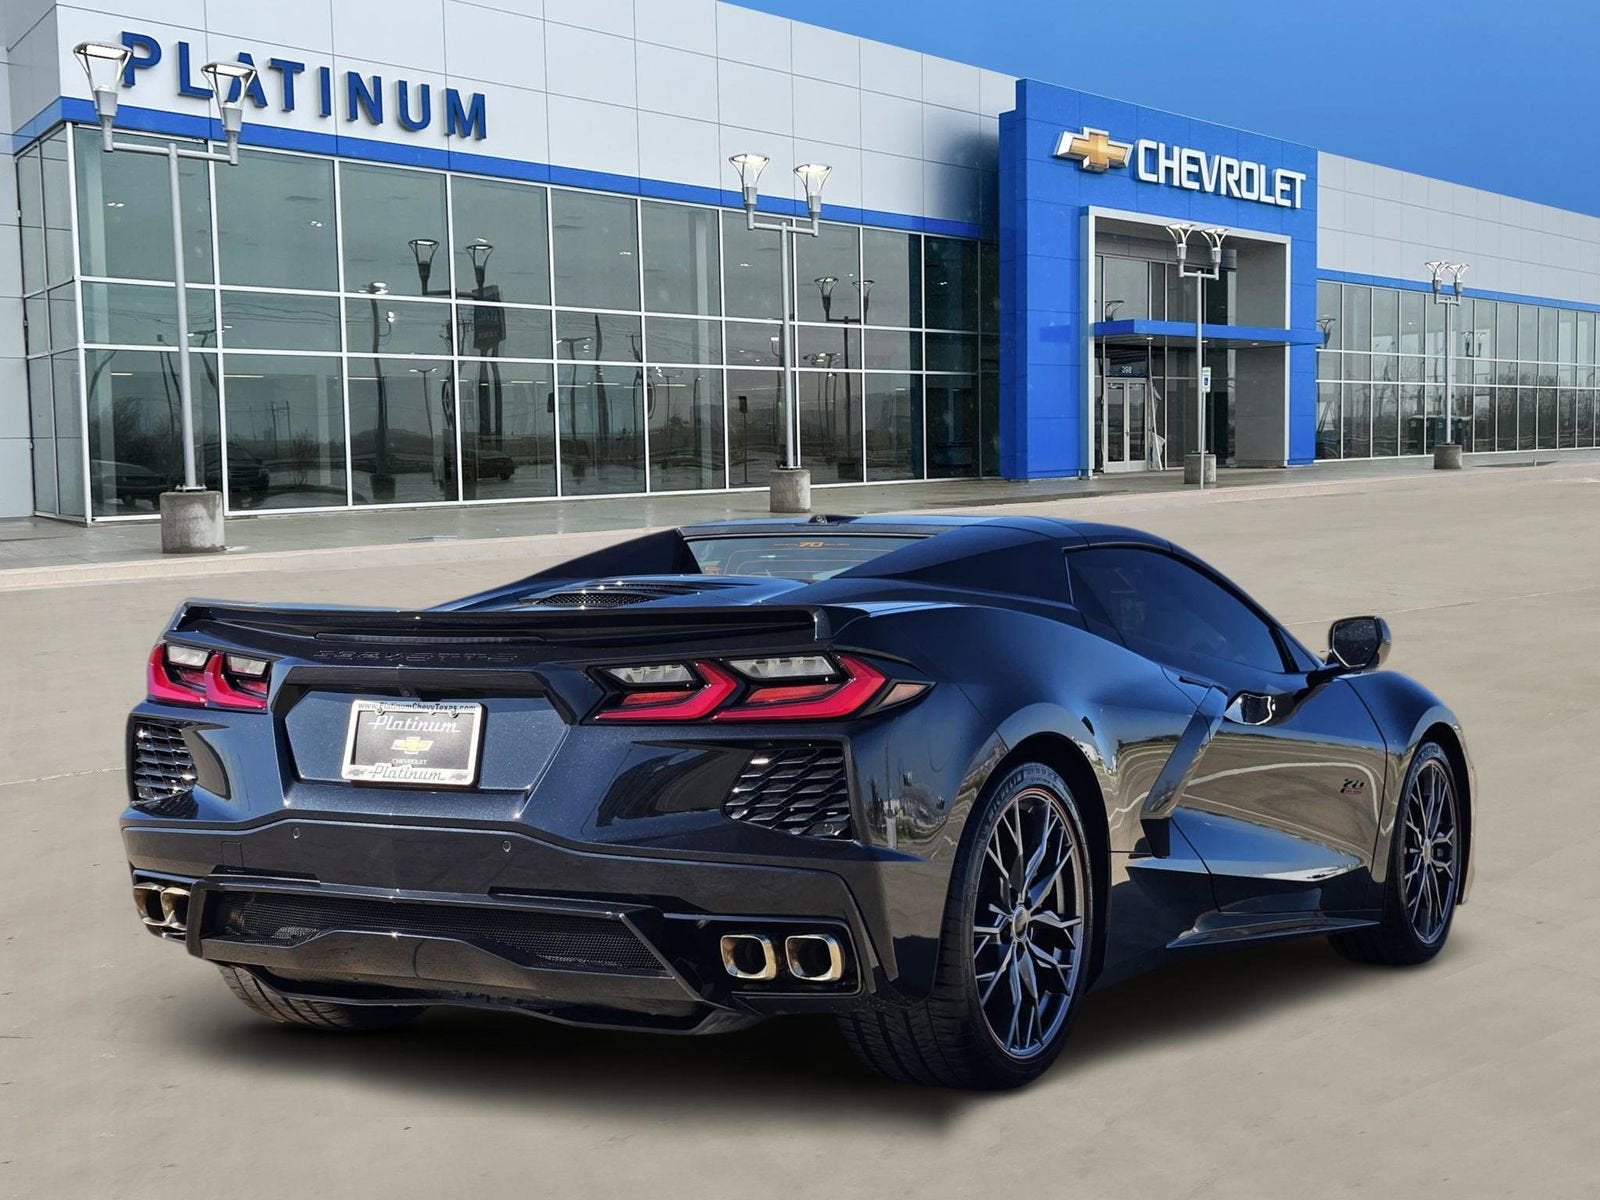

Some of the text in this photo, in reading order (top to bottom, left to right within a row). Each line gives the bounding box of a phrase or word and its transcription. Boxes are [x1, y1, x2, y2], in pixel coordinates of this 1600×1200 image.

[120, 31, 487, 140] PLATINUM
[1137, 138, 1306, 208] CHEVROLET
[368, 715, 461, 732] Platinum
[367, 764, 446, 781] Platinum
